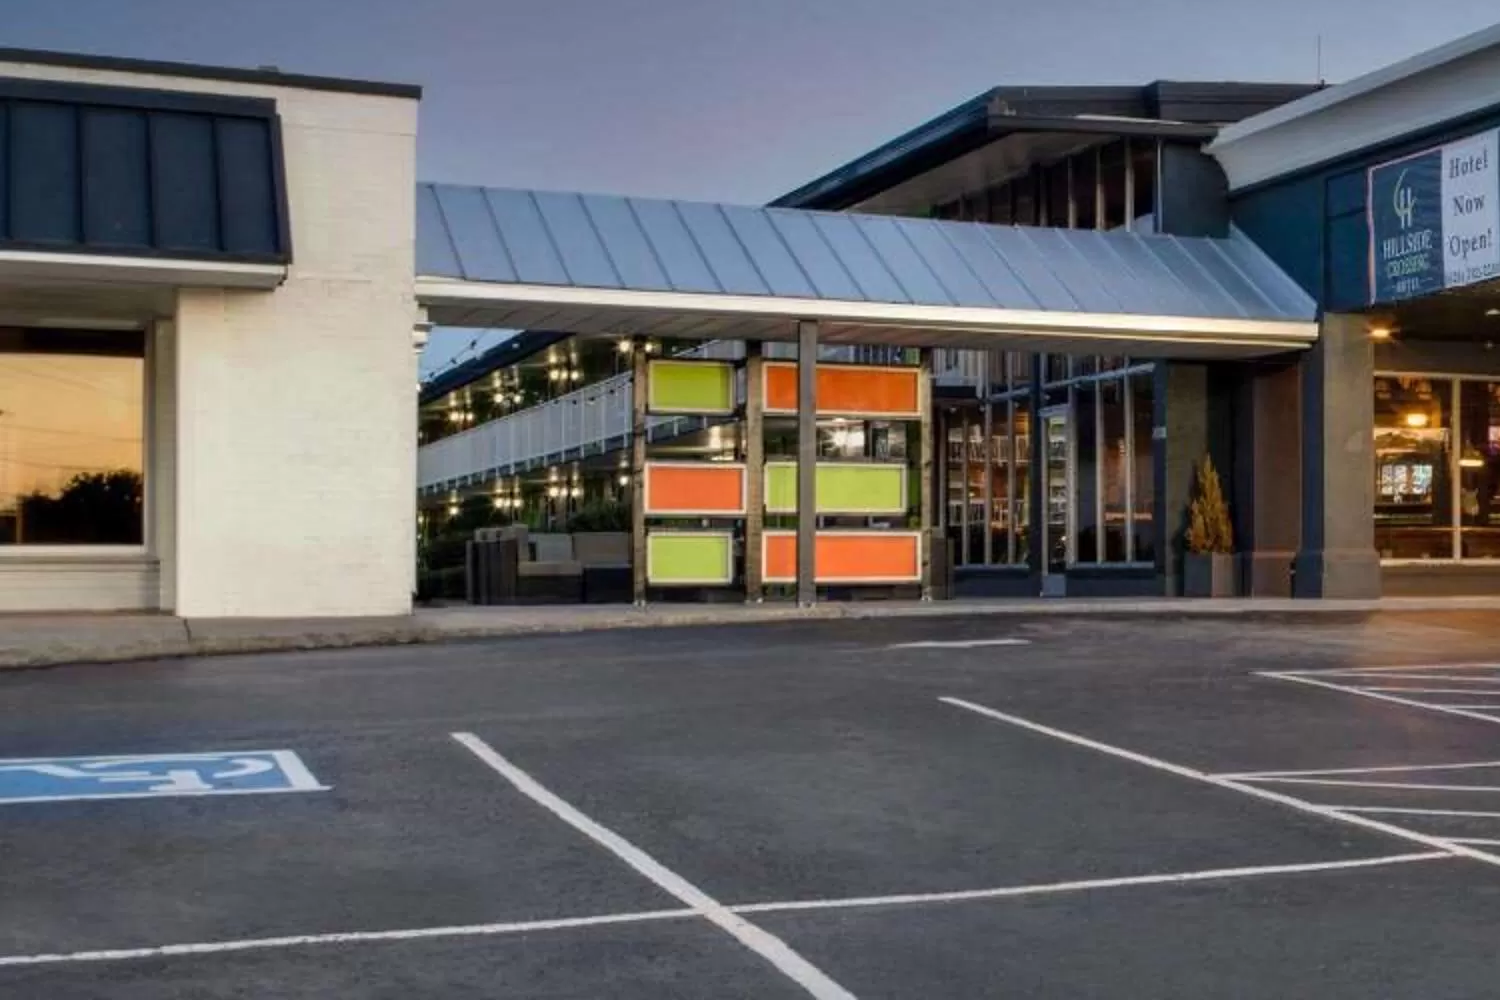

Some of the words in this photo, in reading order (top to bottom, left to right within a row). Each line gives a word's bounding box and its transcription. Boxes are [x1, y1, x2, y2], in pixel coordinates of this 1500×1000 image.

[1450, 149, 1488, 179] Hotel
[1453, 194, 1485, 217] Now
[1383, 229, 1433, 260] HILLSIDE
[1450, 227, 1492, 261] Open!
